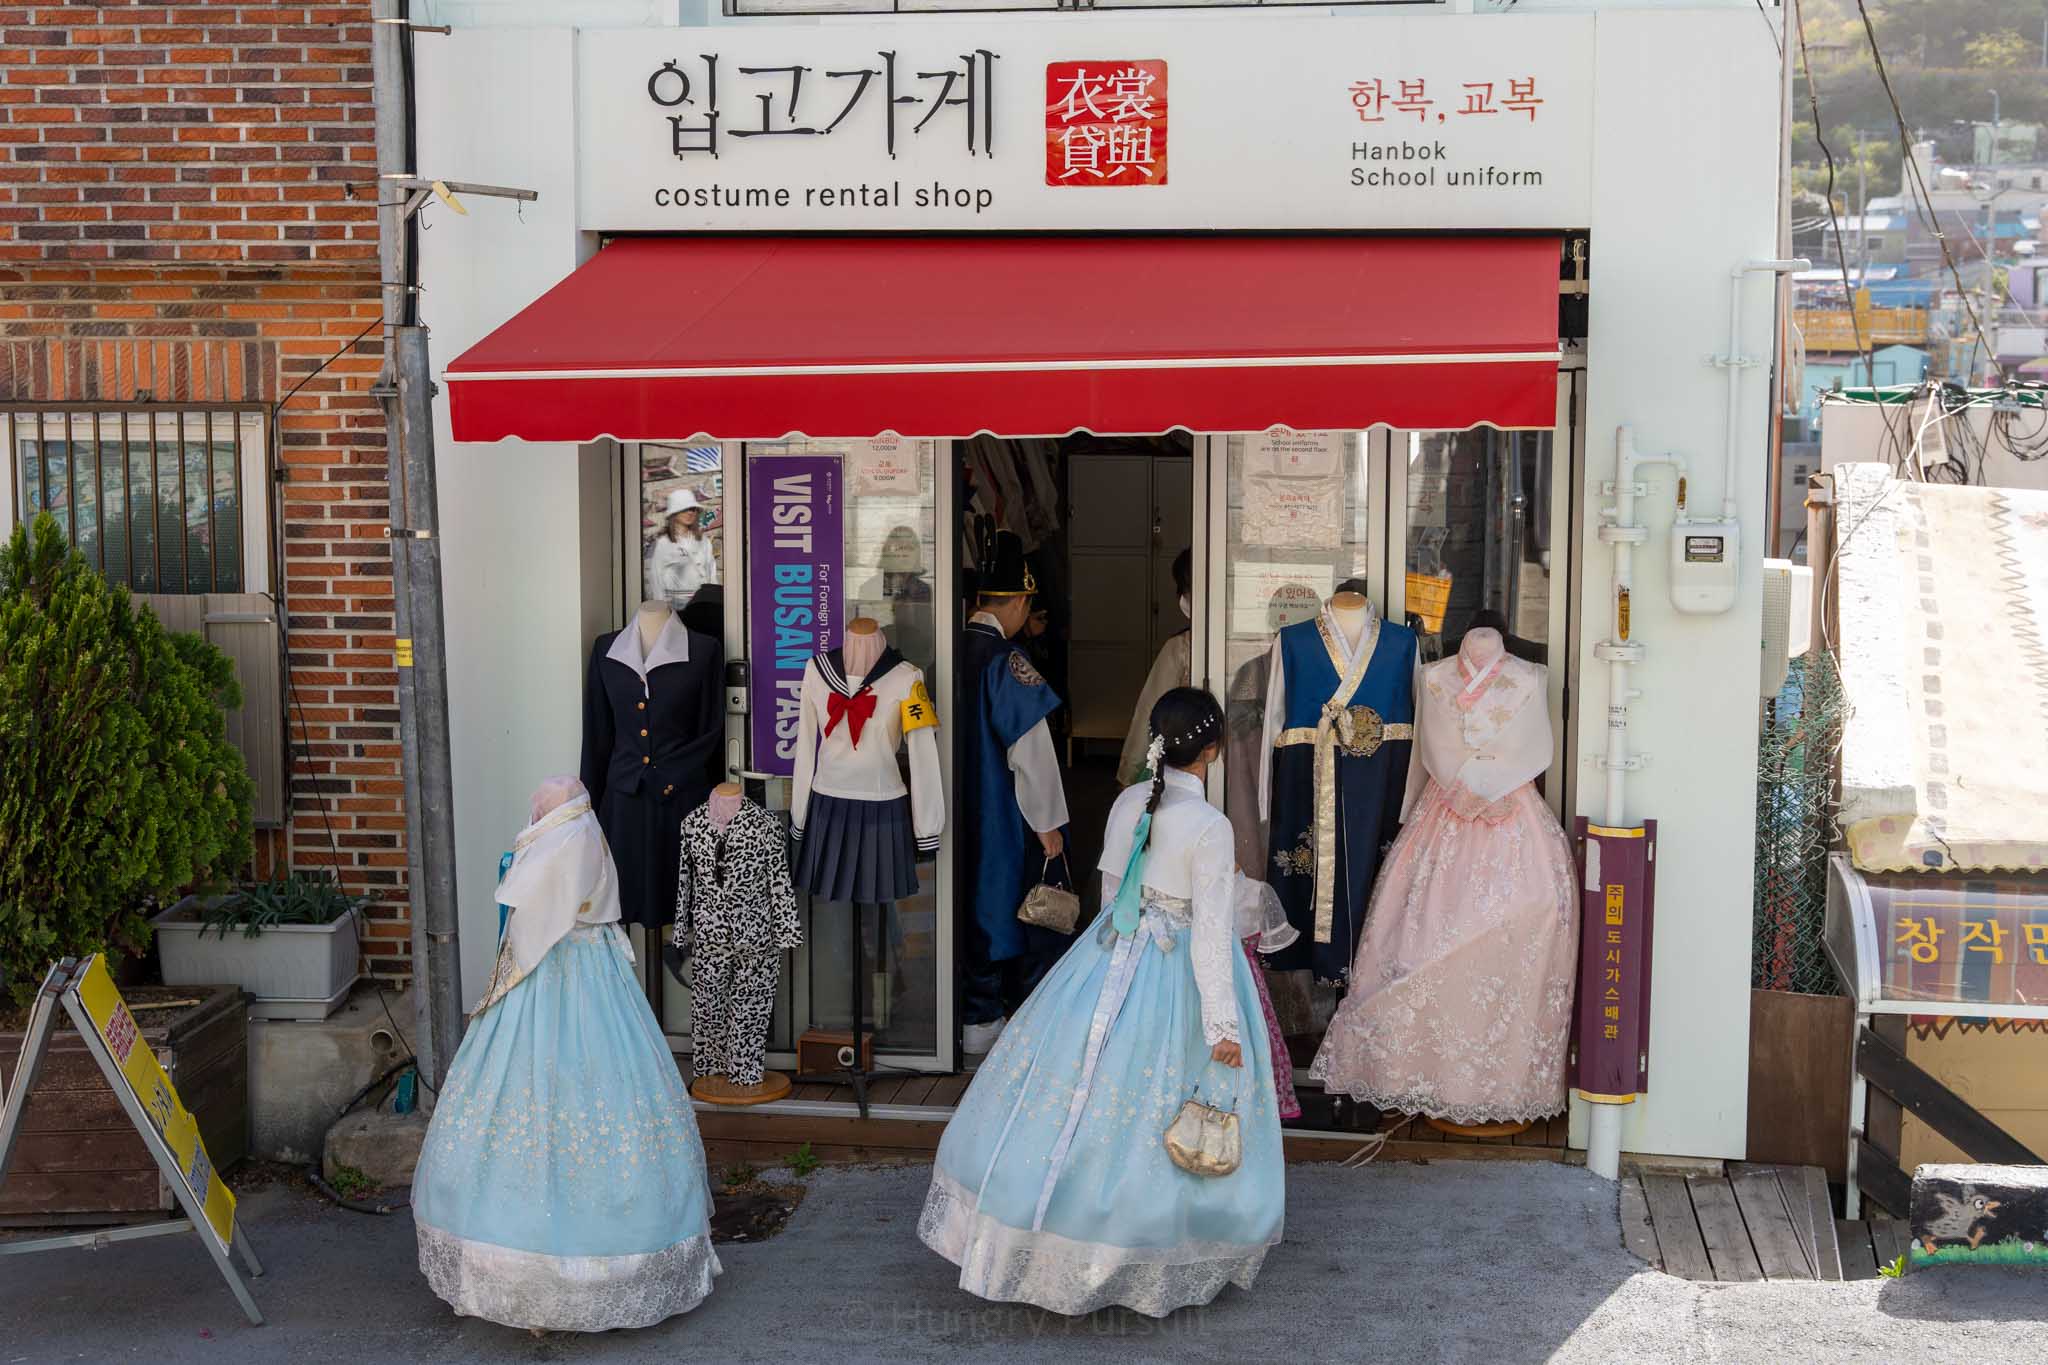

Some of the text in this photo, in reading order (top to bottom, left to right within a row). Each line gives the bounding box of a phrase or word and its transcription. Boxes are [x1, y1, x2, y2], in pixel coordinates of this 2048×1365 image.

[647, 49, 1001, 161] 입고가게
[1057, 67, 1156, 123] 衣裳
[1347, 77, 1544, 125] 한복, 교복
[1351, 140, 1447, 161] Hanbok
[654, 180, 993, 214] costume rental shop
[1351, 166, 1543, 187] School uniform
[819, 563, 830, 582] For
[772, 473, 813, 760] VISIT BUSAN PASS
[817, 585, 831, 626] Foreign
[1605, 885, 1624, 1040] 주의 도시가스배관
